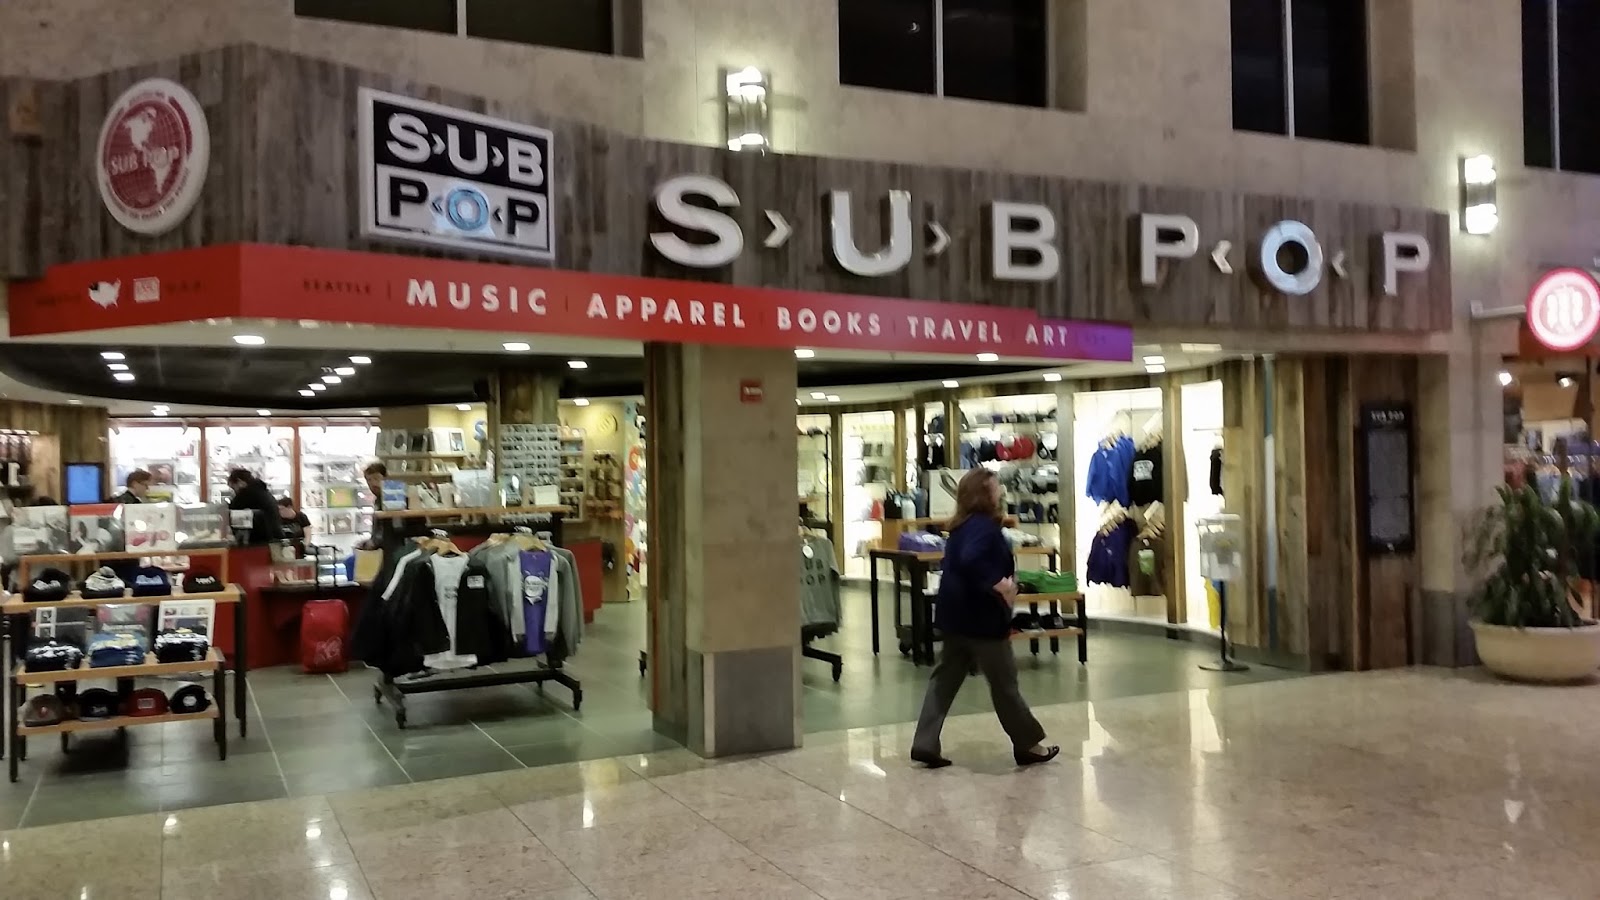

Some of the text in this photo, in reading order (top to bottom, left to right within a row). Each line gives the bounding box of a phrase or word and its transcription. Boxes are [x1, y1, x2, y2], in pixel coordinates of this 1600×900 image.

[111, 153, 139, 175] SUB
[386, 113, 544, 187] SUB
[389, 175, 540, 235] POP
[406, 278, 547, 315] MUSIC
[586, 292, 746, 329] APPAREL
[776, 306, 881, 337] BOOKS
[906, 314, 1002, 344] TRAVEL
[1025, 323, 1068, 347] ART
